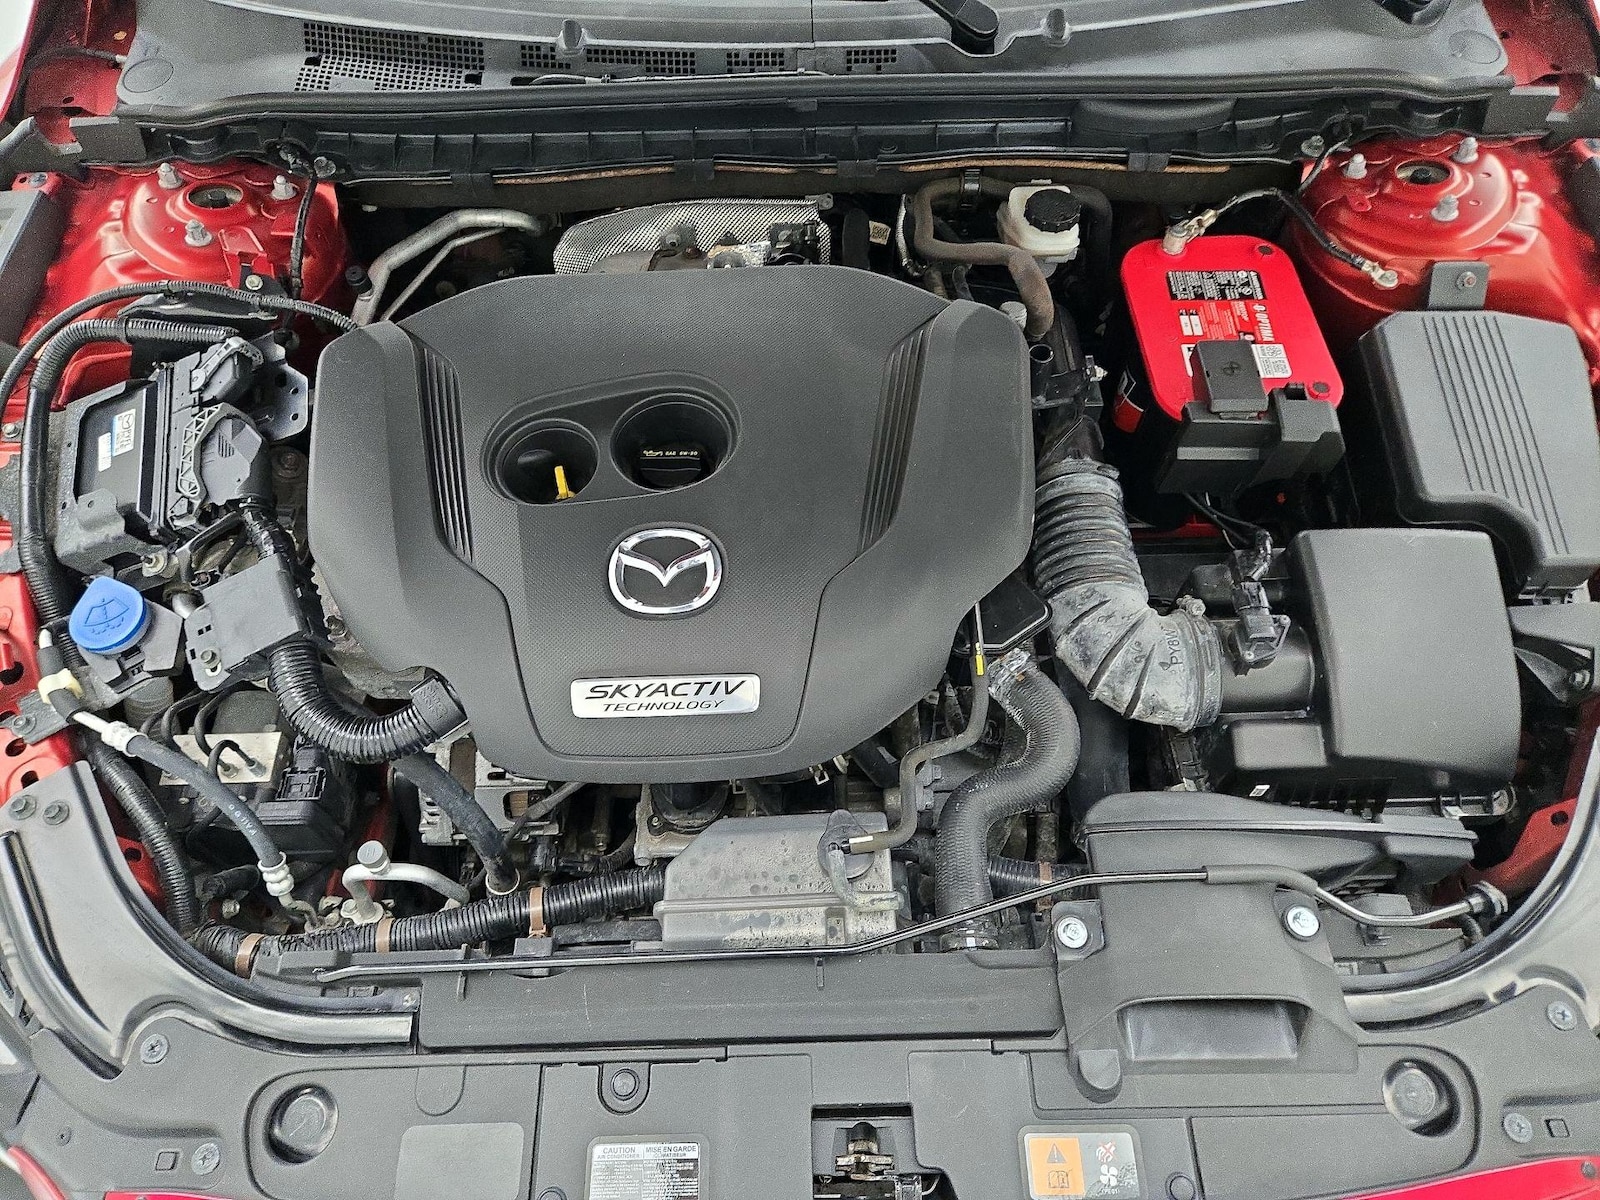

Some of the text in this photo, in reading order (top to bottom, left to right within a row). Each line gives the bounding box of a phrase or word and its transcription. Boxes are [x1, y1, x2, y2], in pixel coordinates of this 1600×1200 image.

[1255, 313, 1275, 342] OPTIMA
[585, 680, 747, 699] SKYACTIV
[603, 699, 725, 712] TECHNOLOGY
